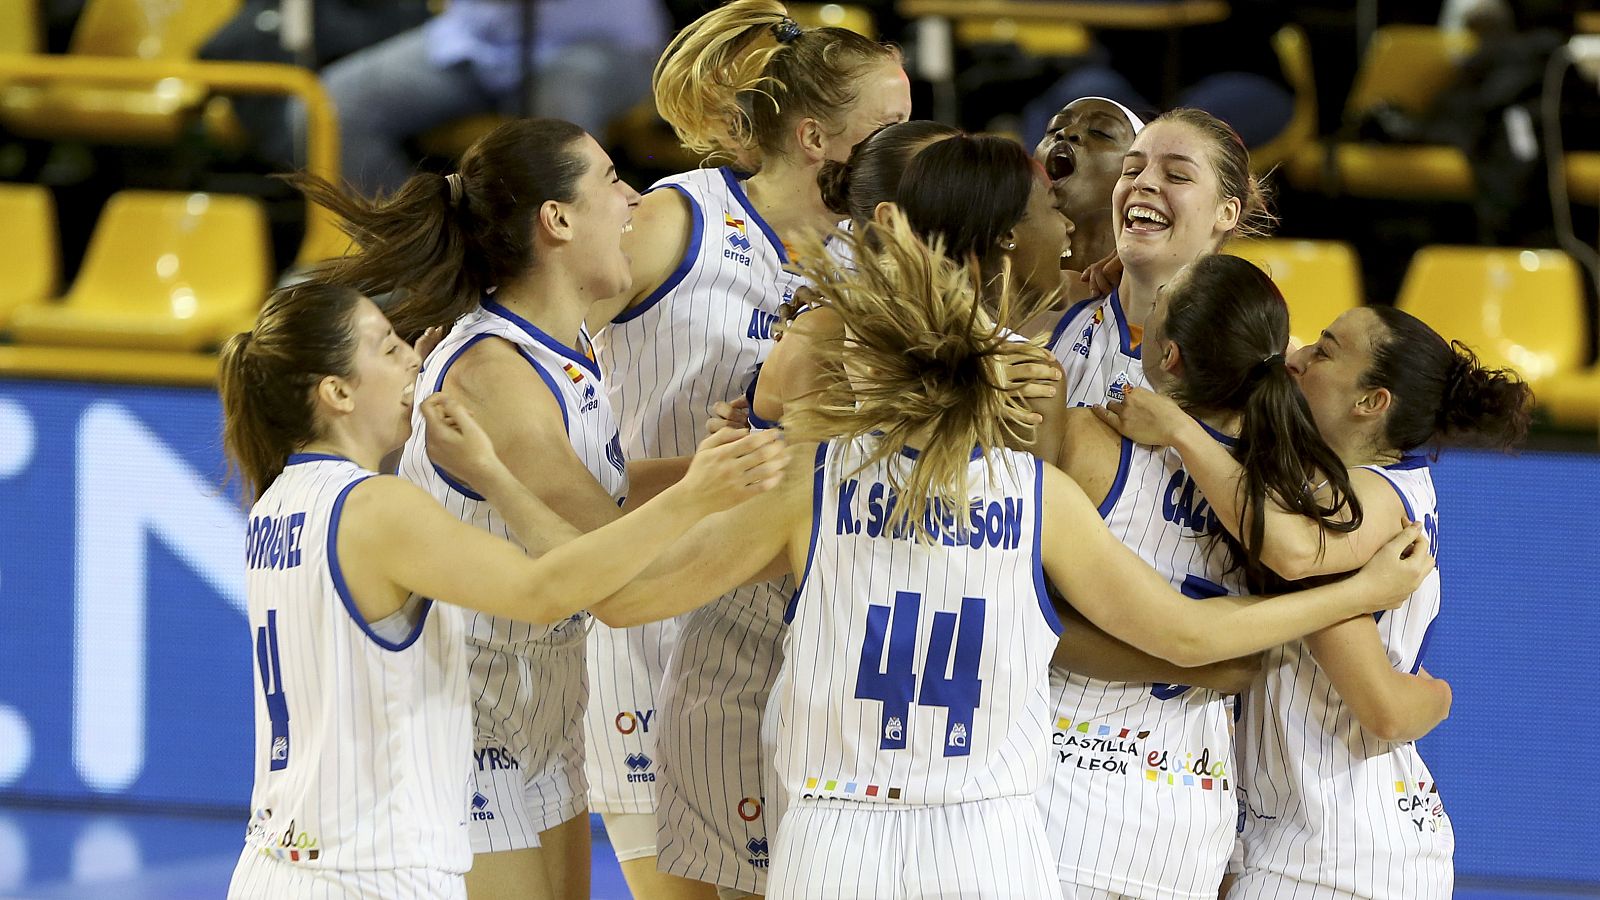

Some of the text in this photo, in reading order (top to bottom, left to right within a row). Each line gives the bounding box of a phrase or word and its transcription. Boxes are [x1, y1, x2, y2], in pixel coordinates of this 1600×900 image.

[724, 249, 751, 266] errea
[747, 308, 780, 339] AV
[836, 480, 862, 535] K.
[854, 591, 986, 757] 44
[1052, 732, 1139, 756] CASTILLA
[1059, 750, 1129, 775] Y LEÓN
[627, 773, 656, 782] errea
